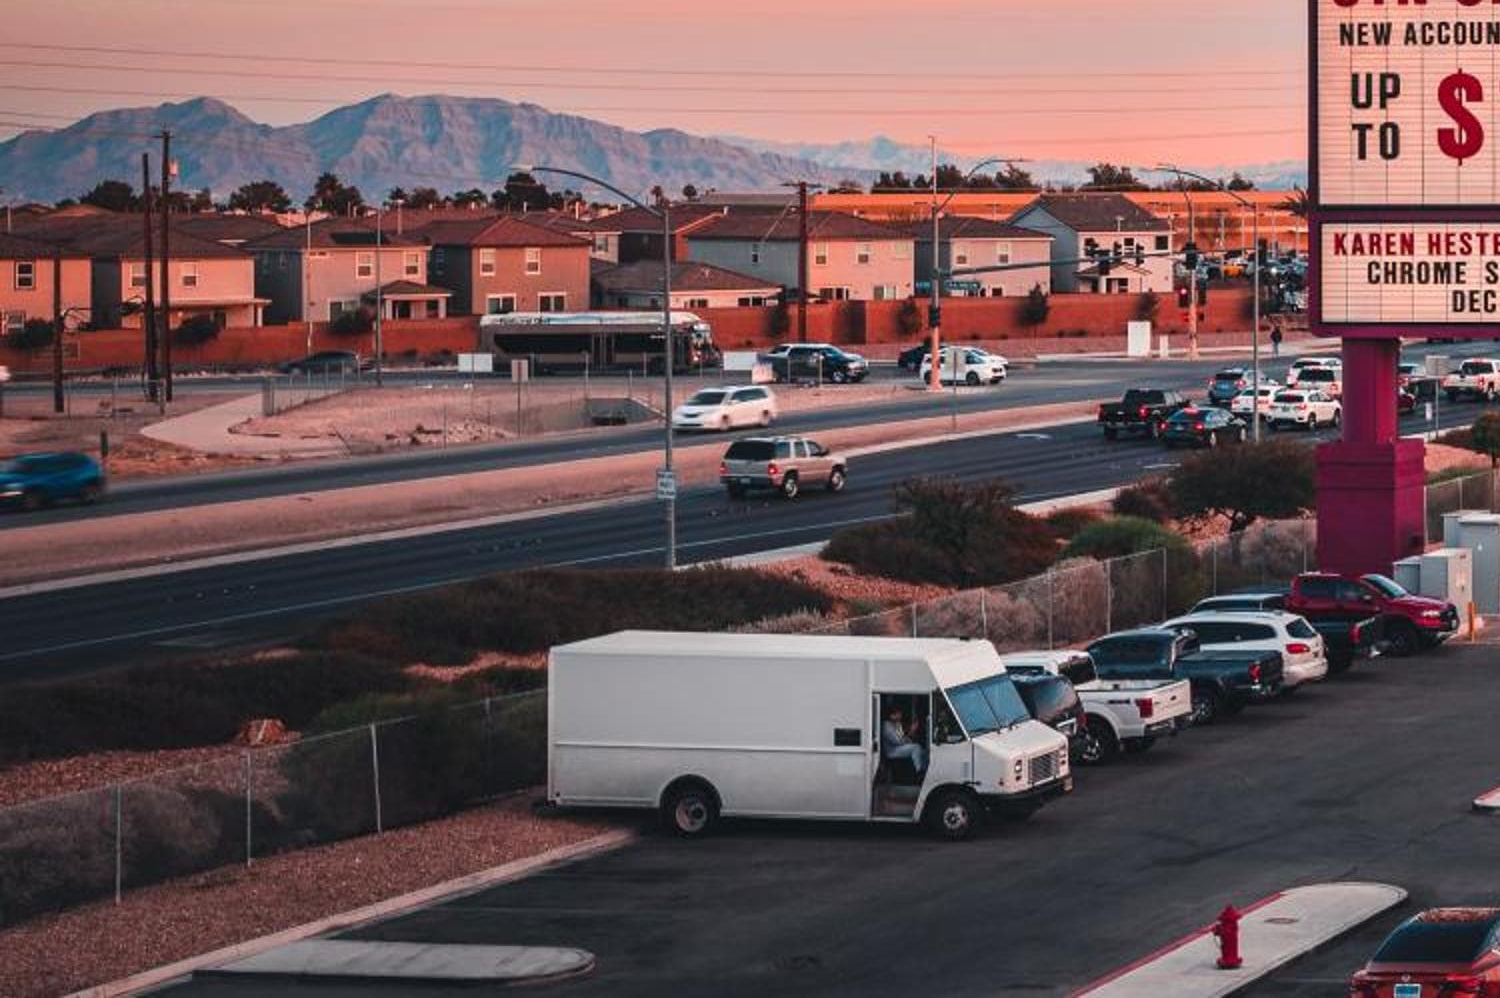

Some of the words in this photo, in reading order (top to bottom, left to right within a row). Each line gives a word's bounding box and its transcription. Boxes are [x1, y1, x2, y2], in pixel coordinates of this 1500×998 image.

[1340, 22, 1392, 46] NEW
[1351, 72, 1401, 109] UP
[1351, 122, 1400, 160] TO
[1333, 233, 1414, 256] KAREN
[1367, 261, 1467, 284] CHROME
[1452, 290, 1497, 313] DEC
